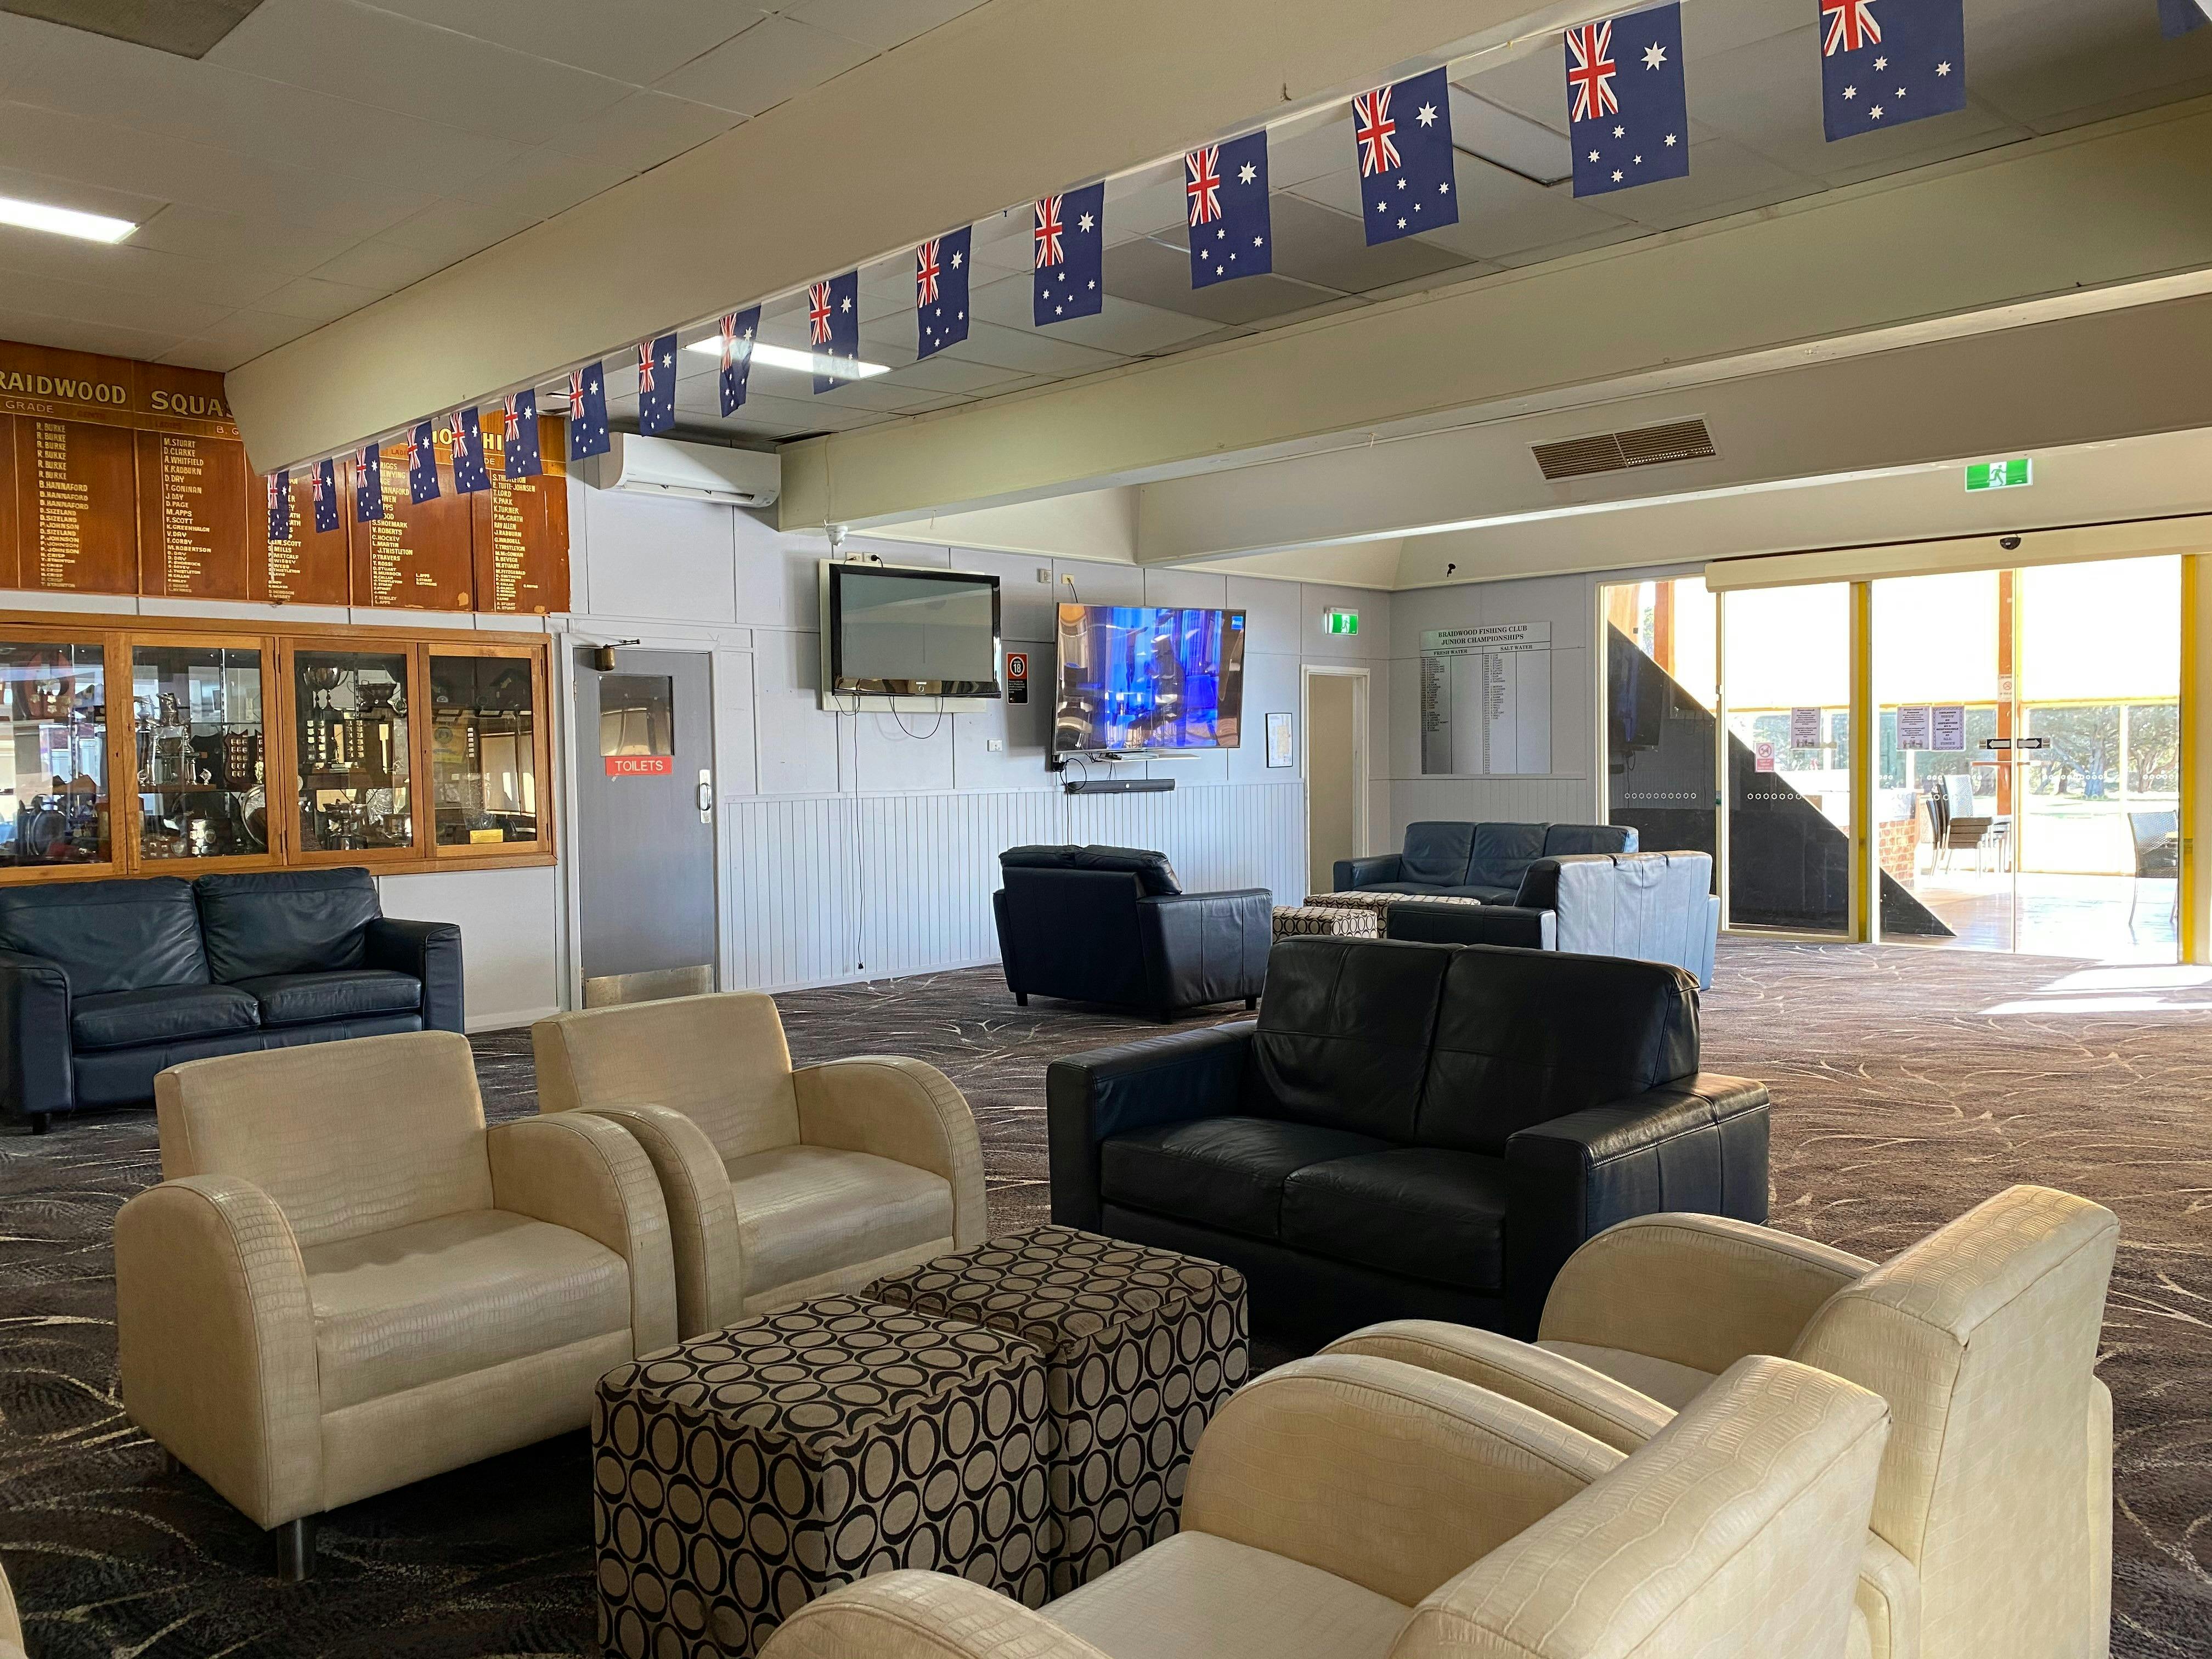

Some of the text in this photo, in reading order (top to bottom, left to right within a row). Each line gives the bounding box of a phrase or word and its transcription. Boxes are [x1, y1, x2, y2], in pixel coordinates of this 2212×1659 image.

[5, 400, 54, 413] GRADE
[1438, 629, 1477, 638] BRAIDWOOD
[1479, 626, 1507, 635] FISHING
[1441, 633, 1524, 645] JUNIOR CHAMPIONSHIPS
[1013, 663, 1021, 673] 18
[614, 760, 664, 771] TOILETS
